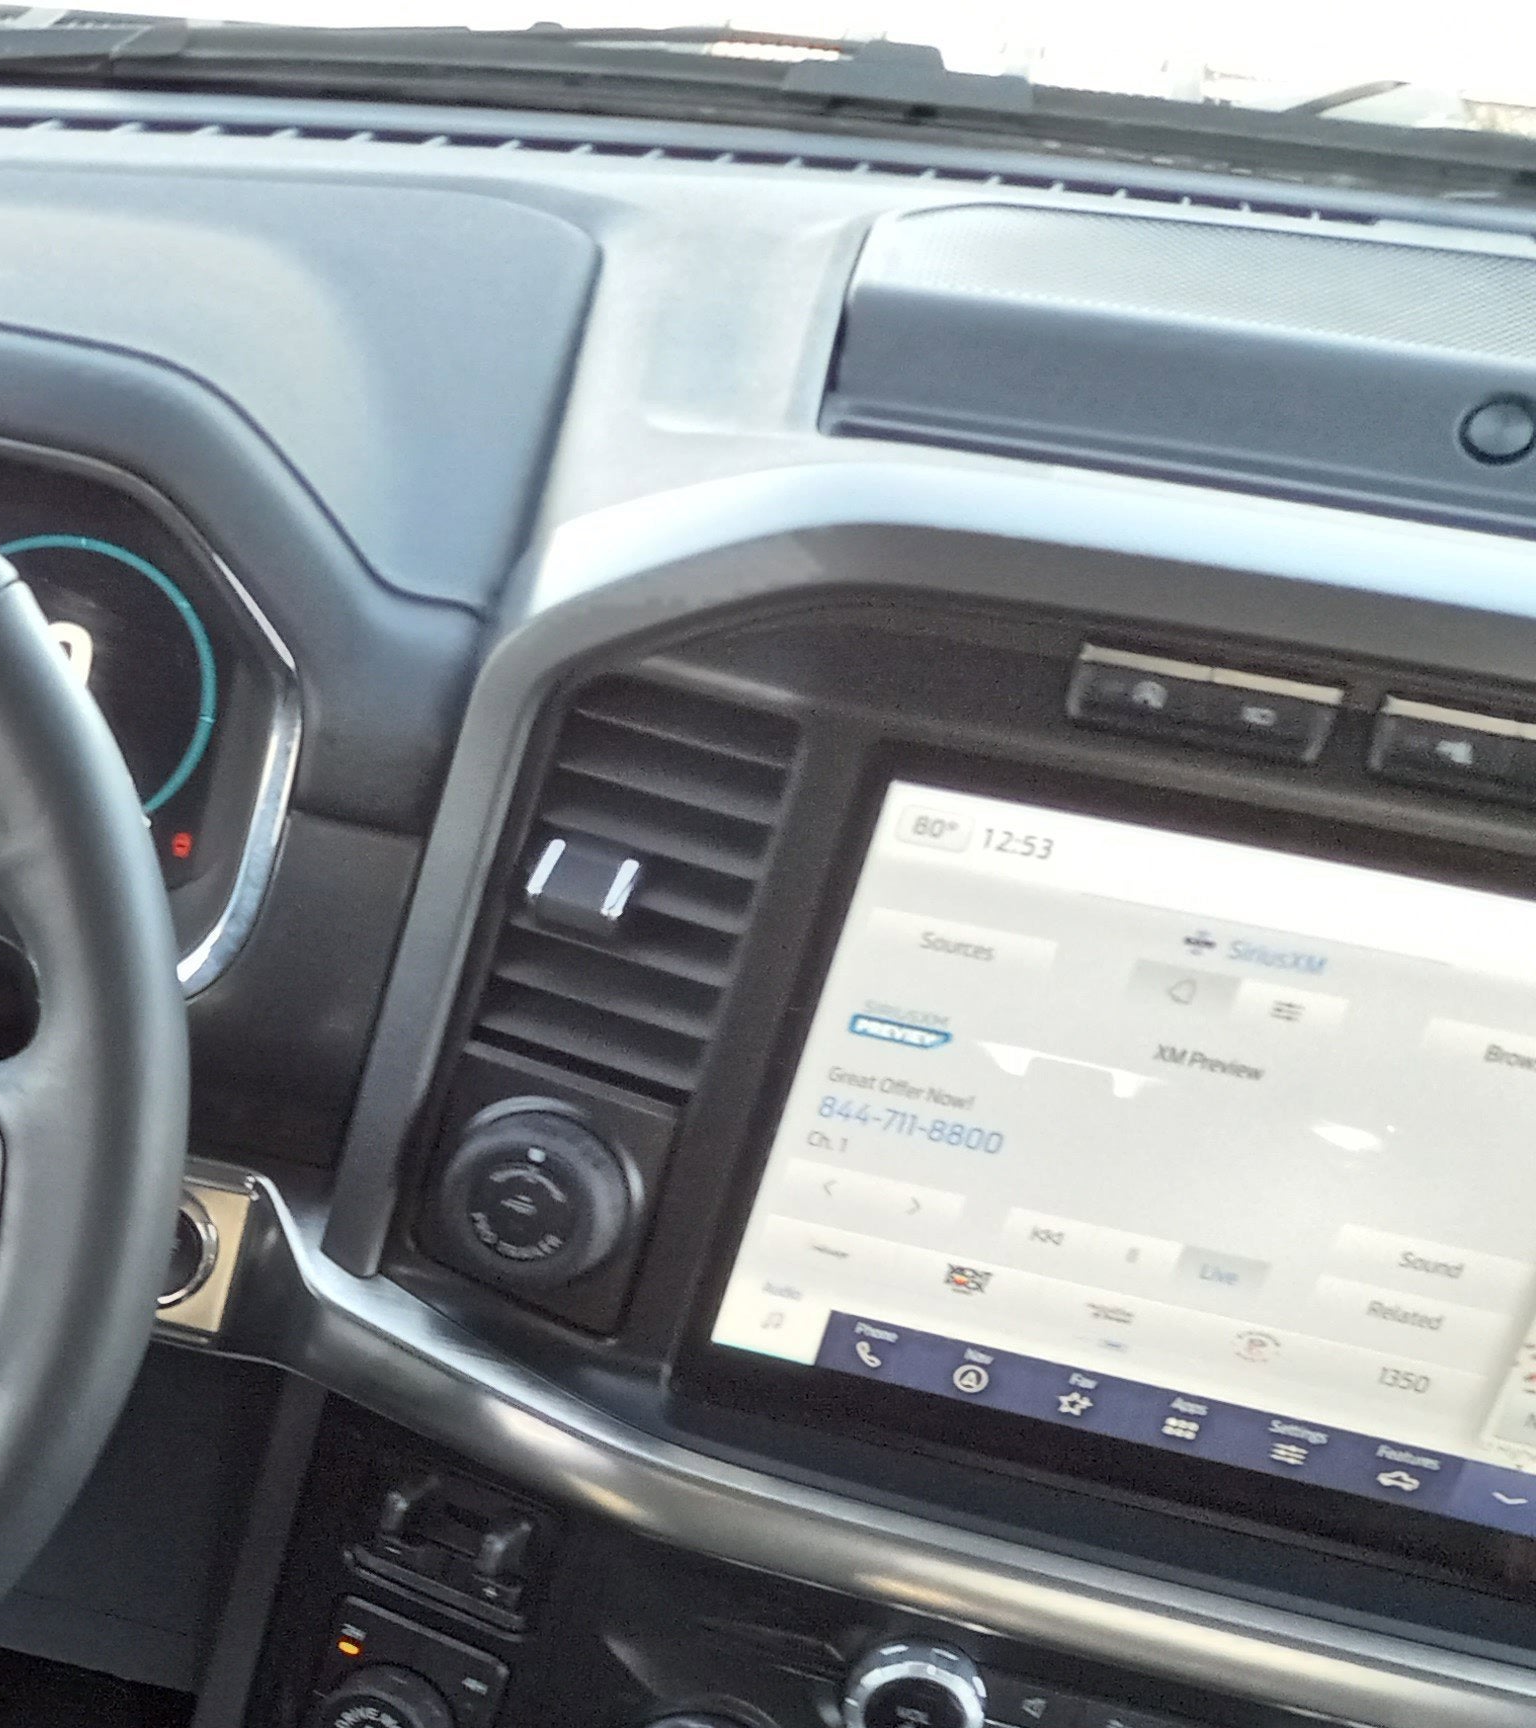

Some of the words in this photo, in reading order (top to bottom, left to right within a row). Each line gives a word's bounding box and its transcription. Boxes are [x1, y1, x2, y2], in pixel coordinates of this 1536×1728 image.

[982, 827, 1054, 860] 12:53
[920, 931, 995, 962] Sources
[1228, 939, 1328, 975] SiriusXM
[1153, 1044, 1187, 1065] XM
[1188, 1051, 1265, 1081] Preview
[1484, 1043, 1536, 1074] Brow
[827, 1066, 877, 1090] Great
[879, 1077, 925, 1099] Offer
[818, 1096, 1004, 1154] 844-711-8800
[1199, 1263, 1239, 1285] Live
[1398, 1251, 1465, 1280] Sound
[1366, 1299, 1445, 1331] Related
[854, 1321, 899, 1343] Phone
[963, 1348, 994, 1365] Nav
[1379, 1366, 1431, 1395] 1350
[1170, 1397, 1208, 1417] Apps
[1268, 1419, 1329, 1446] Settings
[1376, 1445, 1440, 1471] Features
